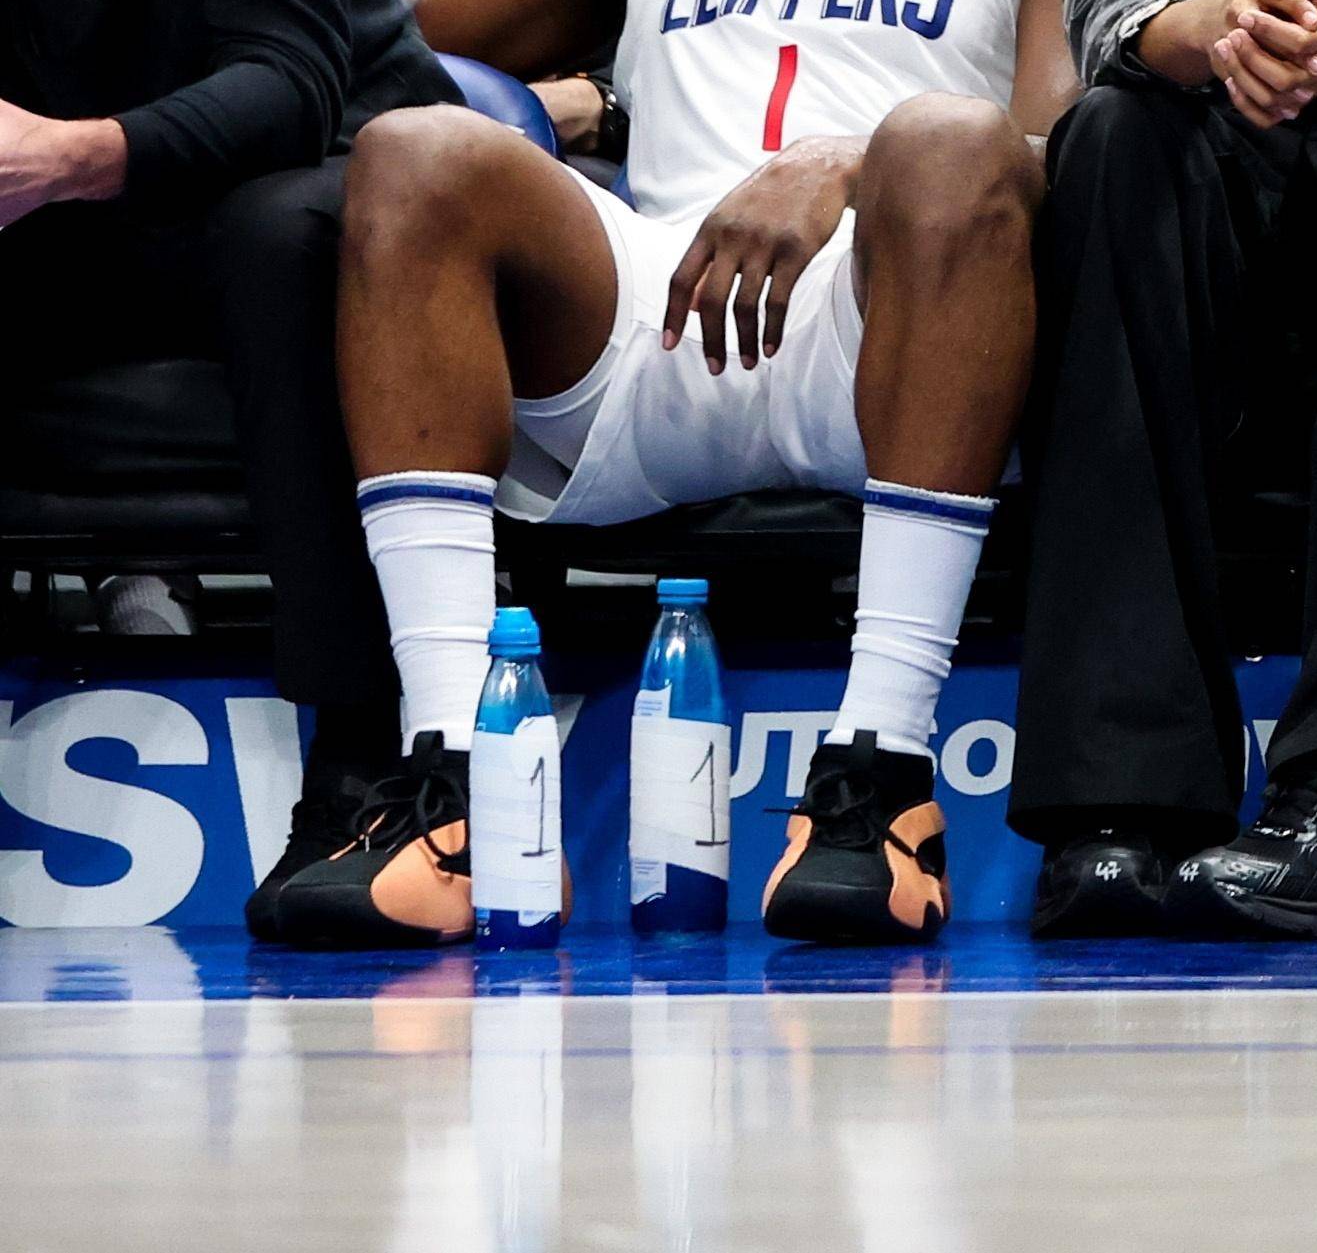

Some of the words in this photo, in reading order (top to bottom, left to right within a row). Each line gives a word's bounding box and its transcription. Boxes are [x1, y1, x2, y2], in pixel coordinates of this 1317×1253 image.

[762, 44, 798, 151] 1
[521, 756, 556, 857] 1
[690, 741, 731, 846] 1
